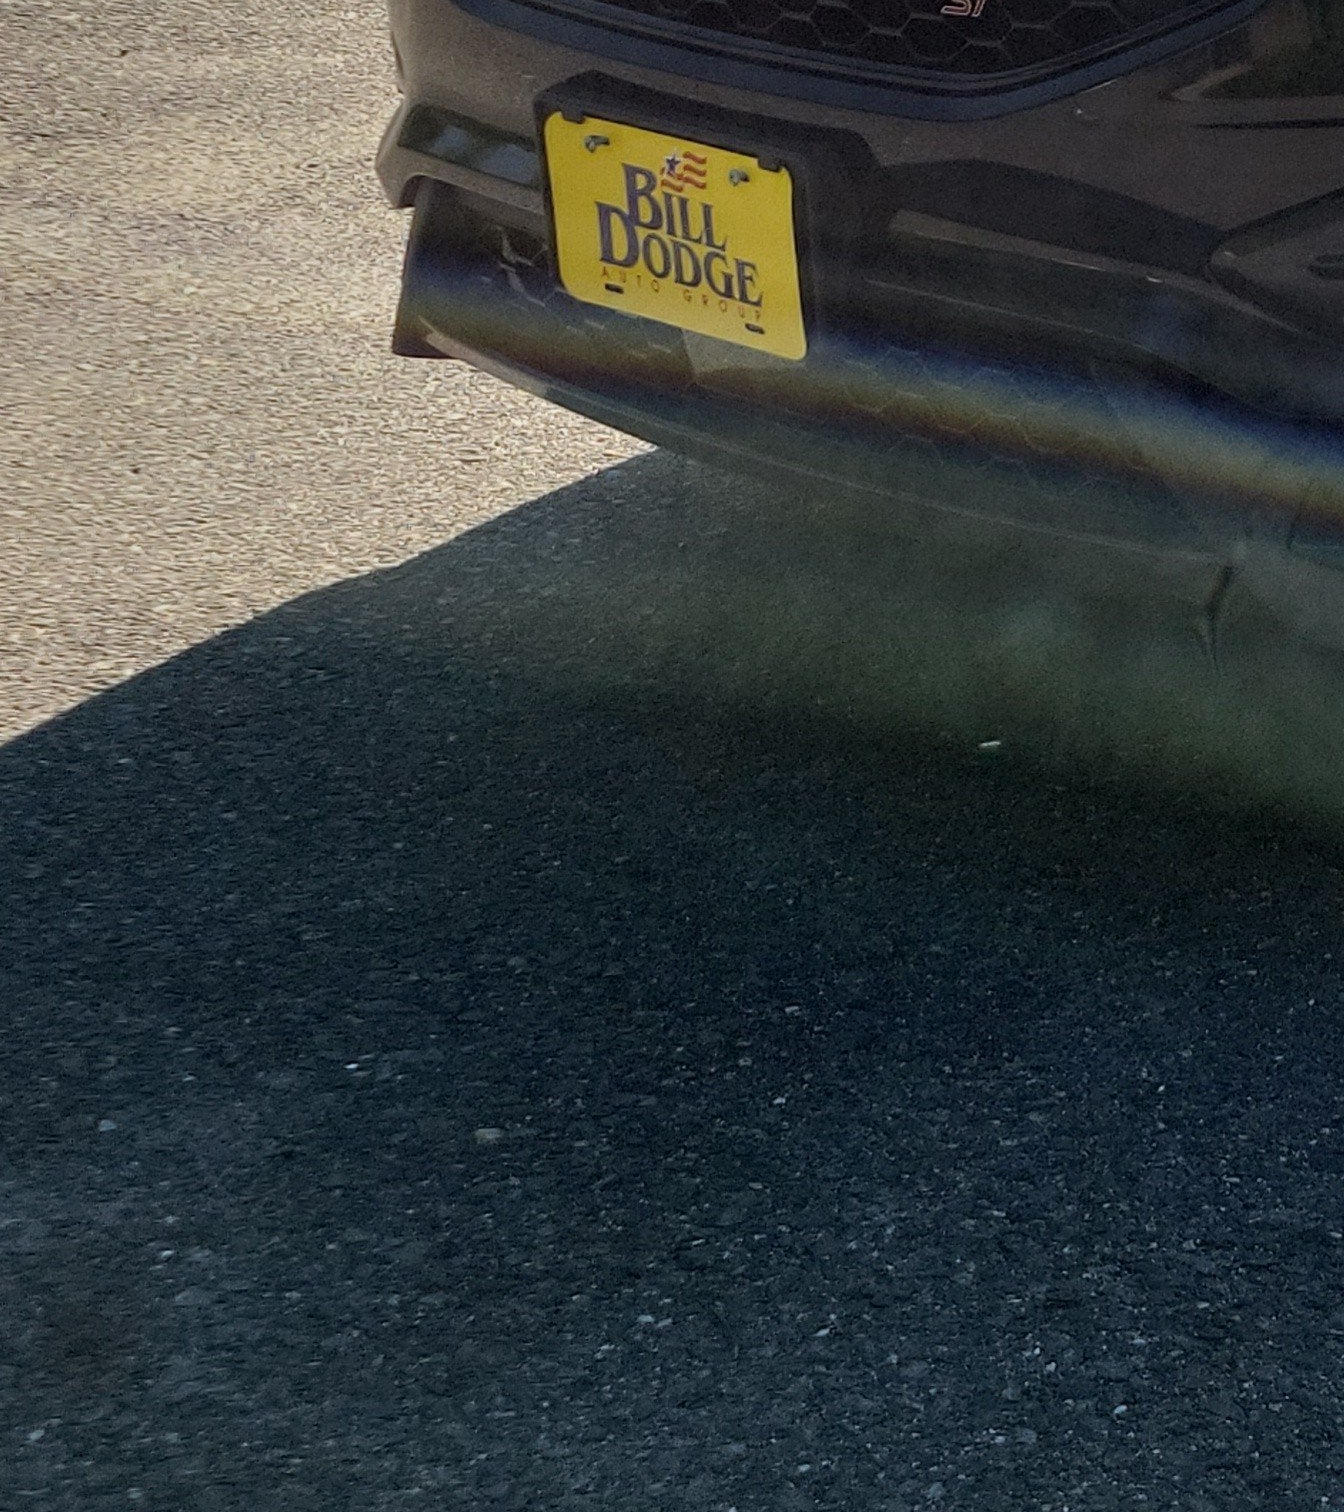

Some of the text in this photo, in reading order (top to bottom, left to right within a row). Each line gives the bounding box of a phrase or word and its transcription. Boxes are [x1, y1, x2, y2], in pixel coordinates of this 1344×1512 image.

[621, 162, 727, 253] BILL
[595, 200, 764, 308] DODGE
[600, 266, 661, 294] AUTO
